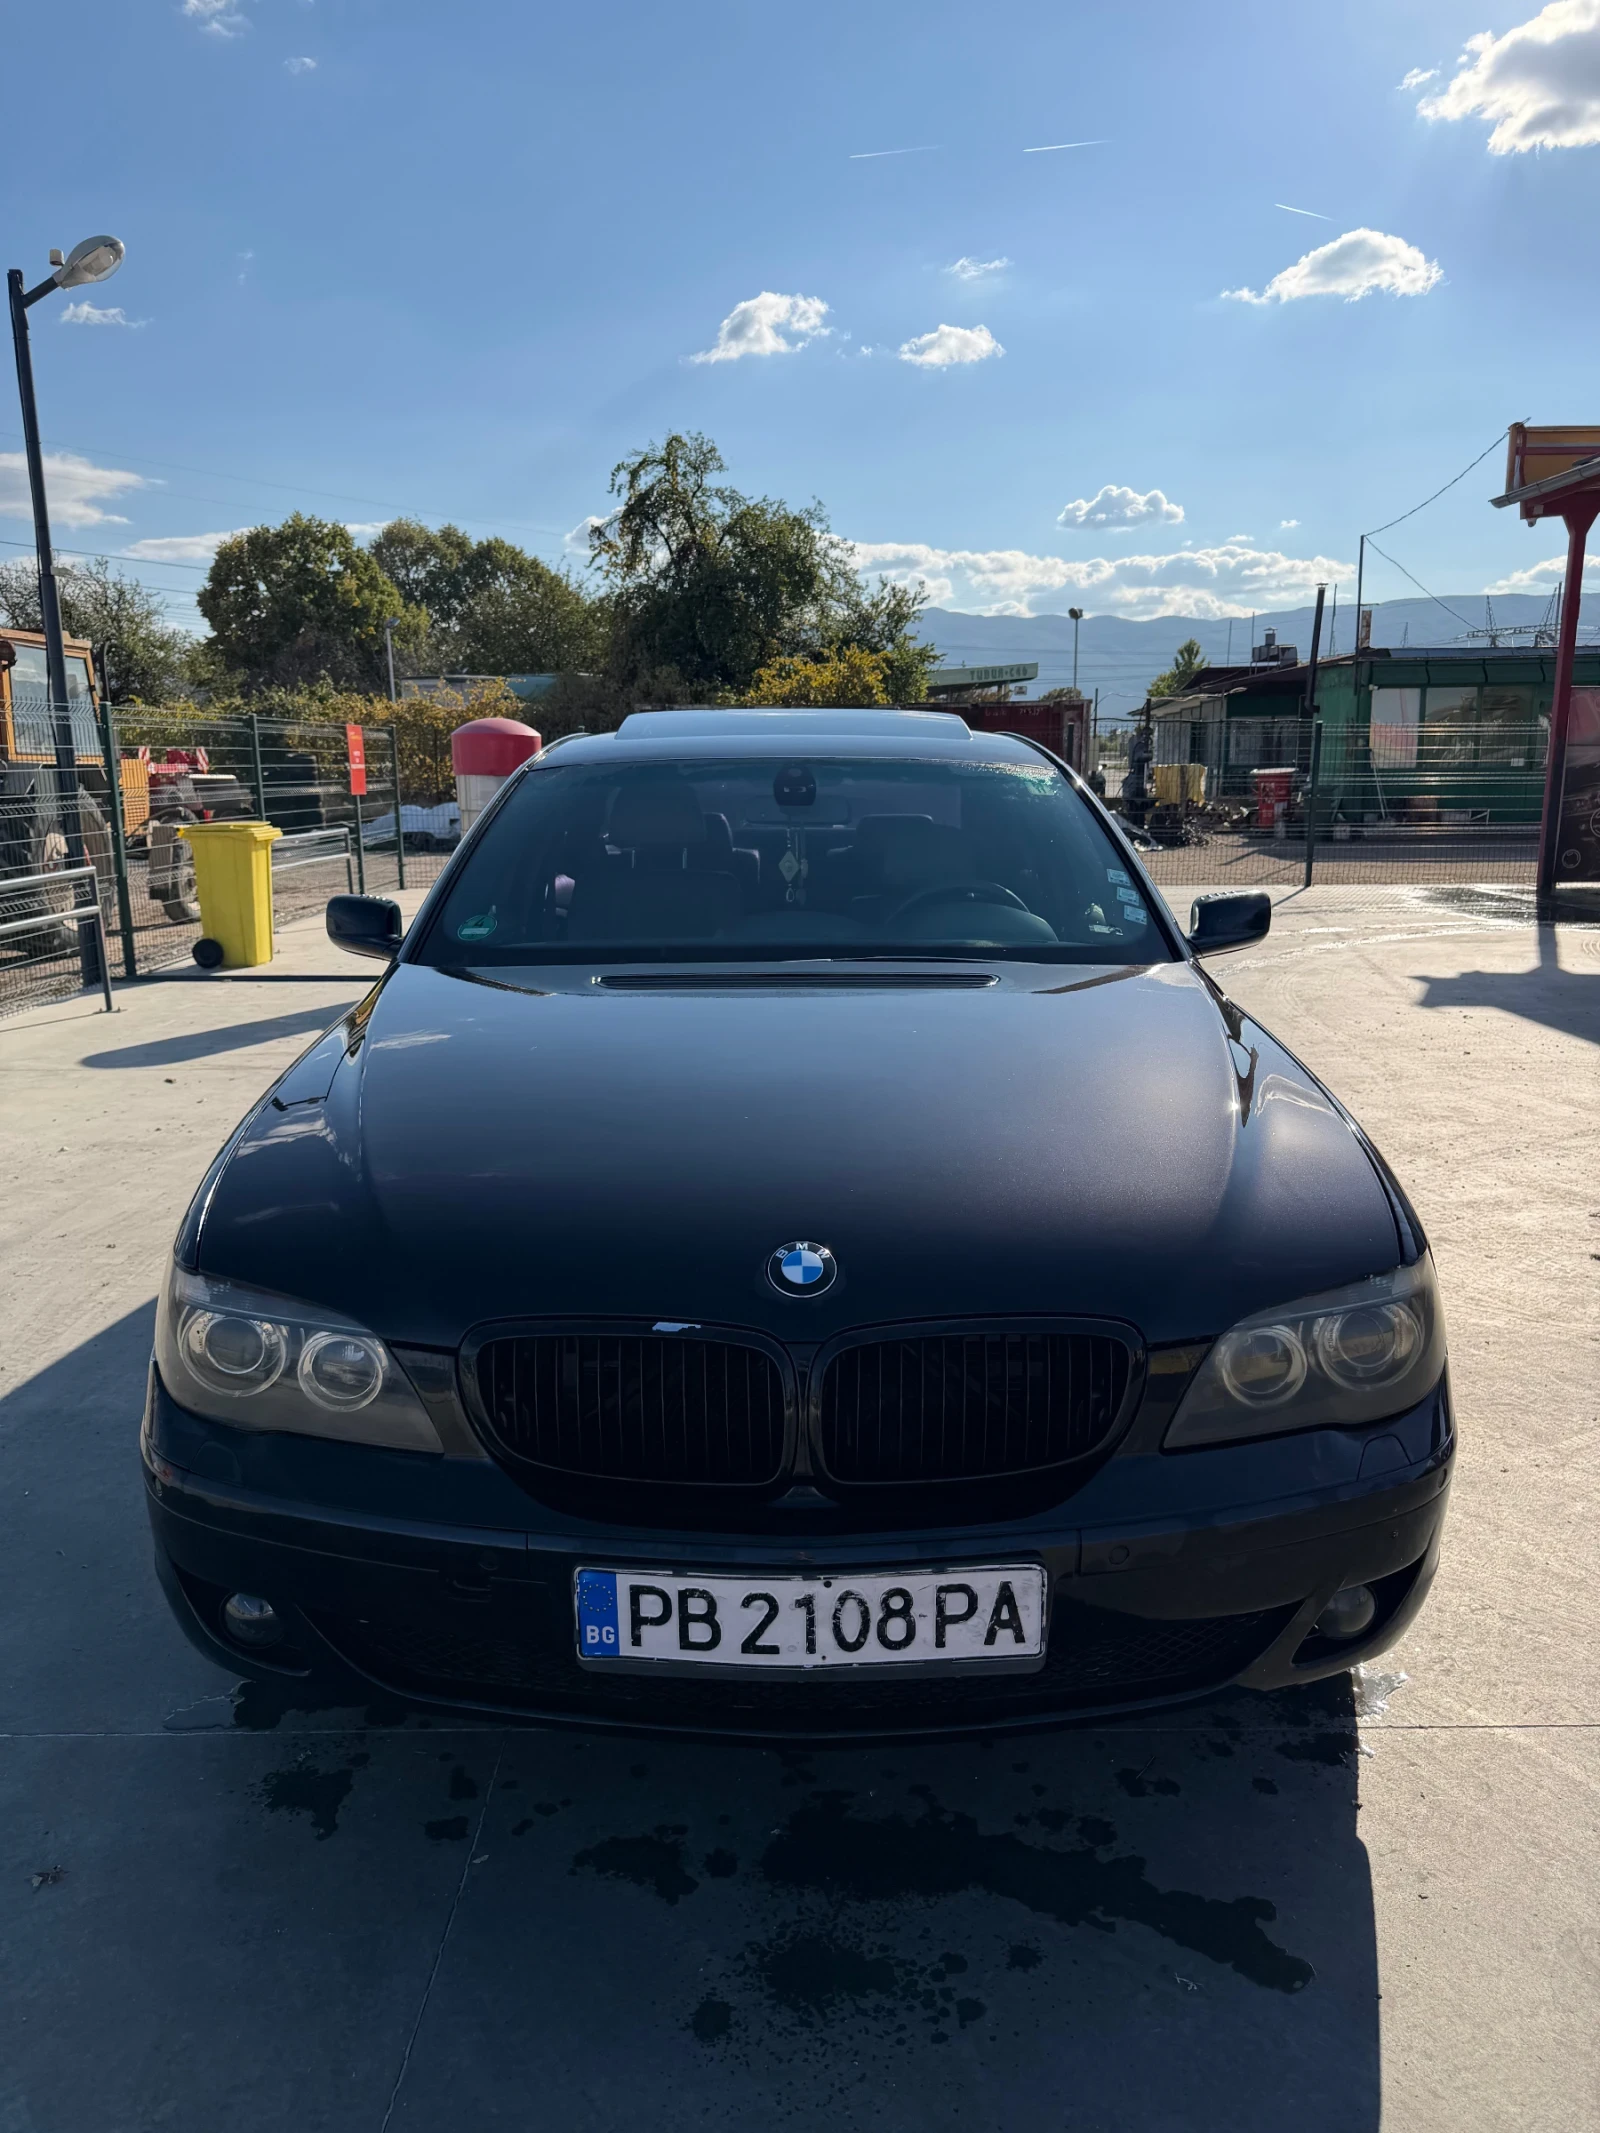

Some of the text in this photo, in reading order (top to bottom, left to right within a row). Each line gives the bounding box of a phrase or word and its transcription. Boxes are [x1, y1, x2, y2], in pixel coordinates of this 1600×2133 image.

[776, 1242, 830, 1259] BMW
[740, 1587, 917, 1655] 2108
[586, 1625, 615, 1644] BG
